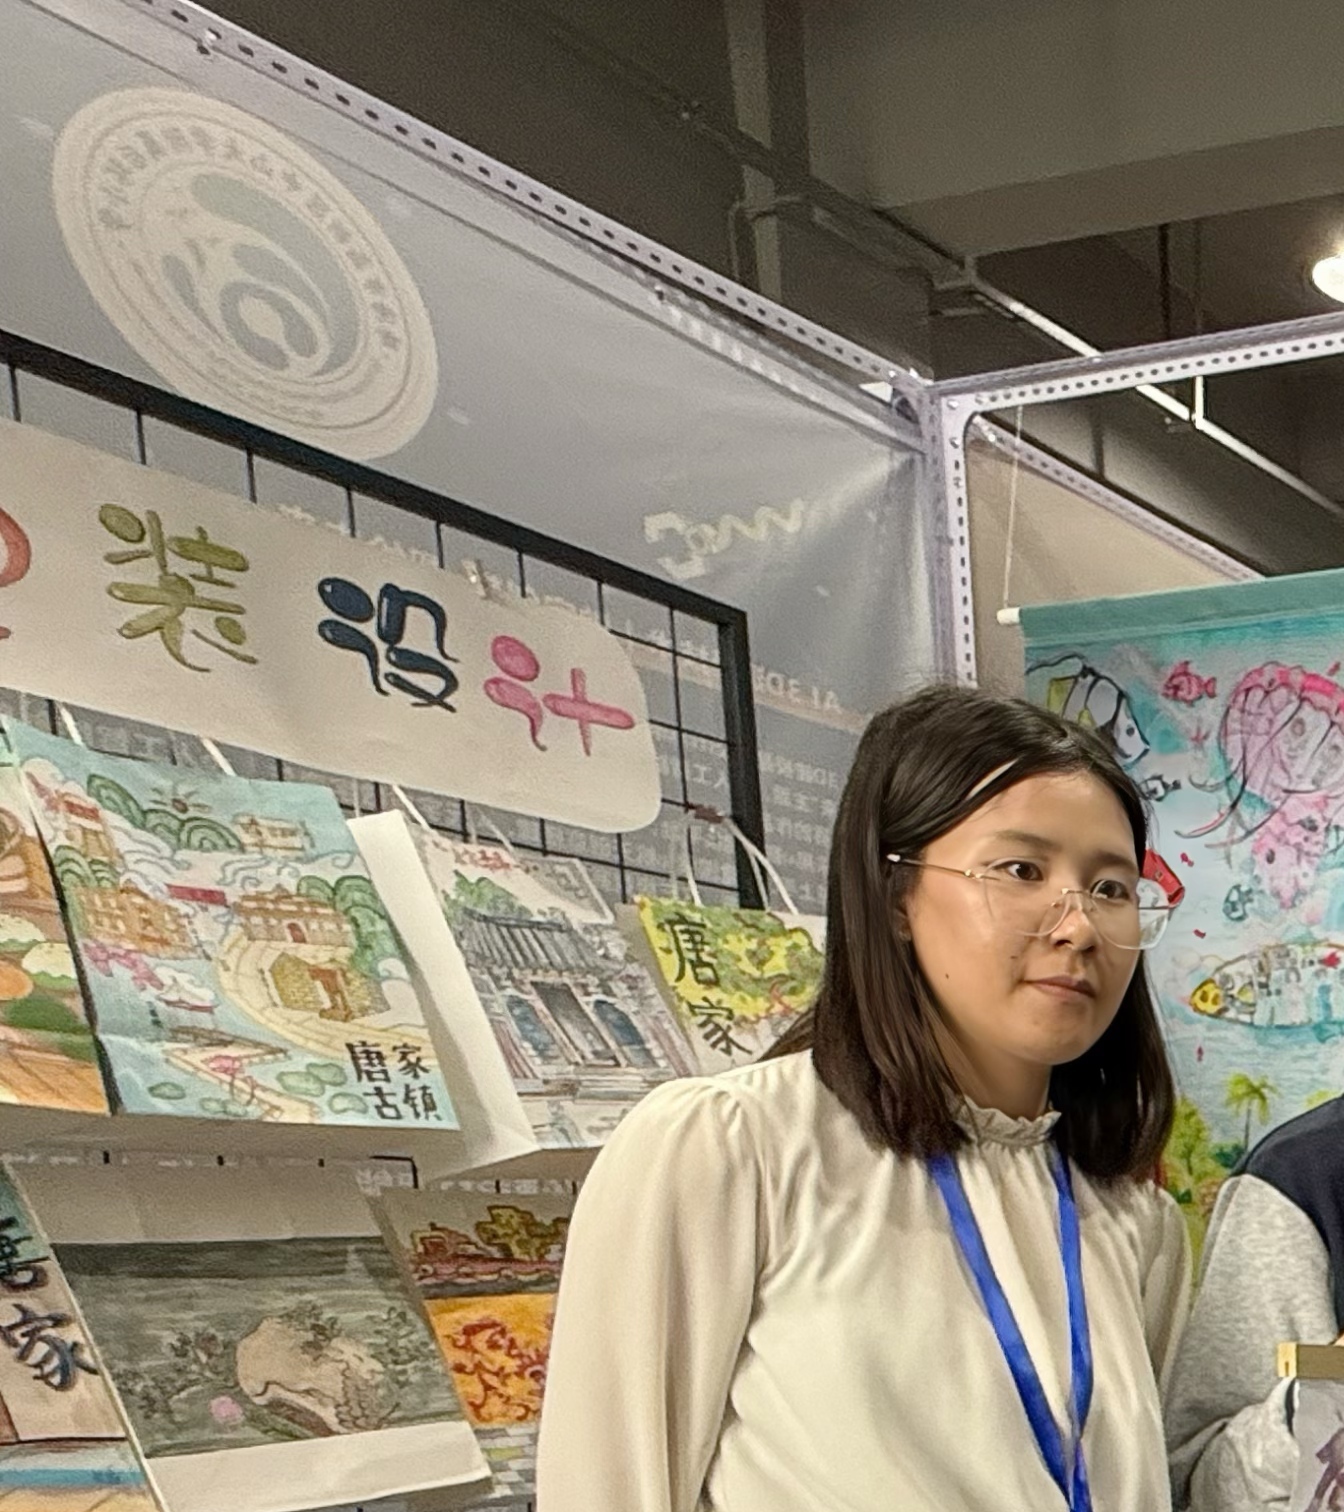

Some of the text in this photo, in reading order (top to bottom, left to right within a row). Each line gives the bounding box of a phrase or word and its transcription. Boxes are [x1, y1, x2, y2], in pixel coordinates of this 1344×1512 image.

[0, 500, 636, 758] 装设计
[346, 1040, 432, 1084] 唐家
[363, 1083, 443, 1123] 古镇
